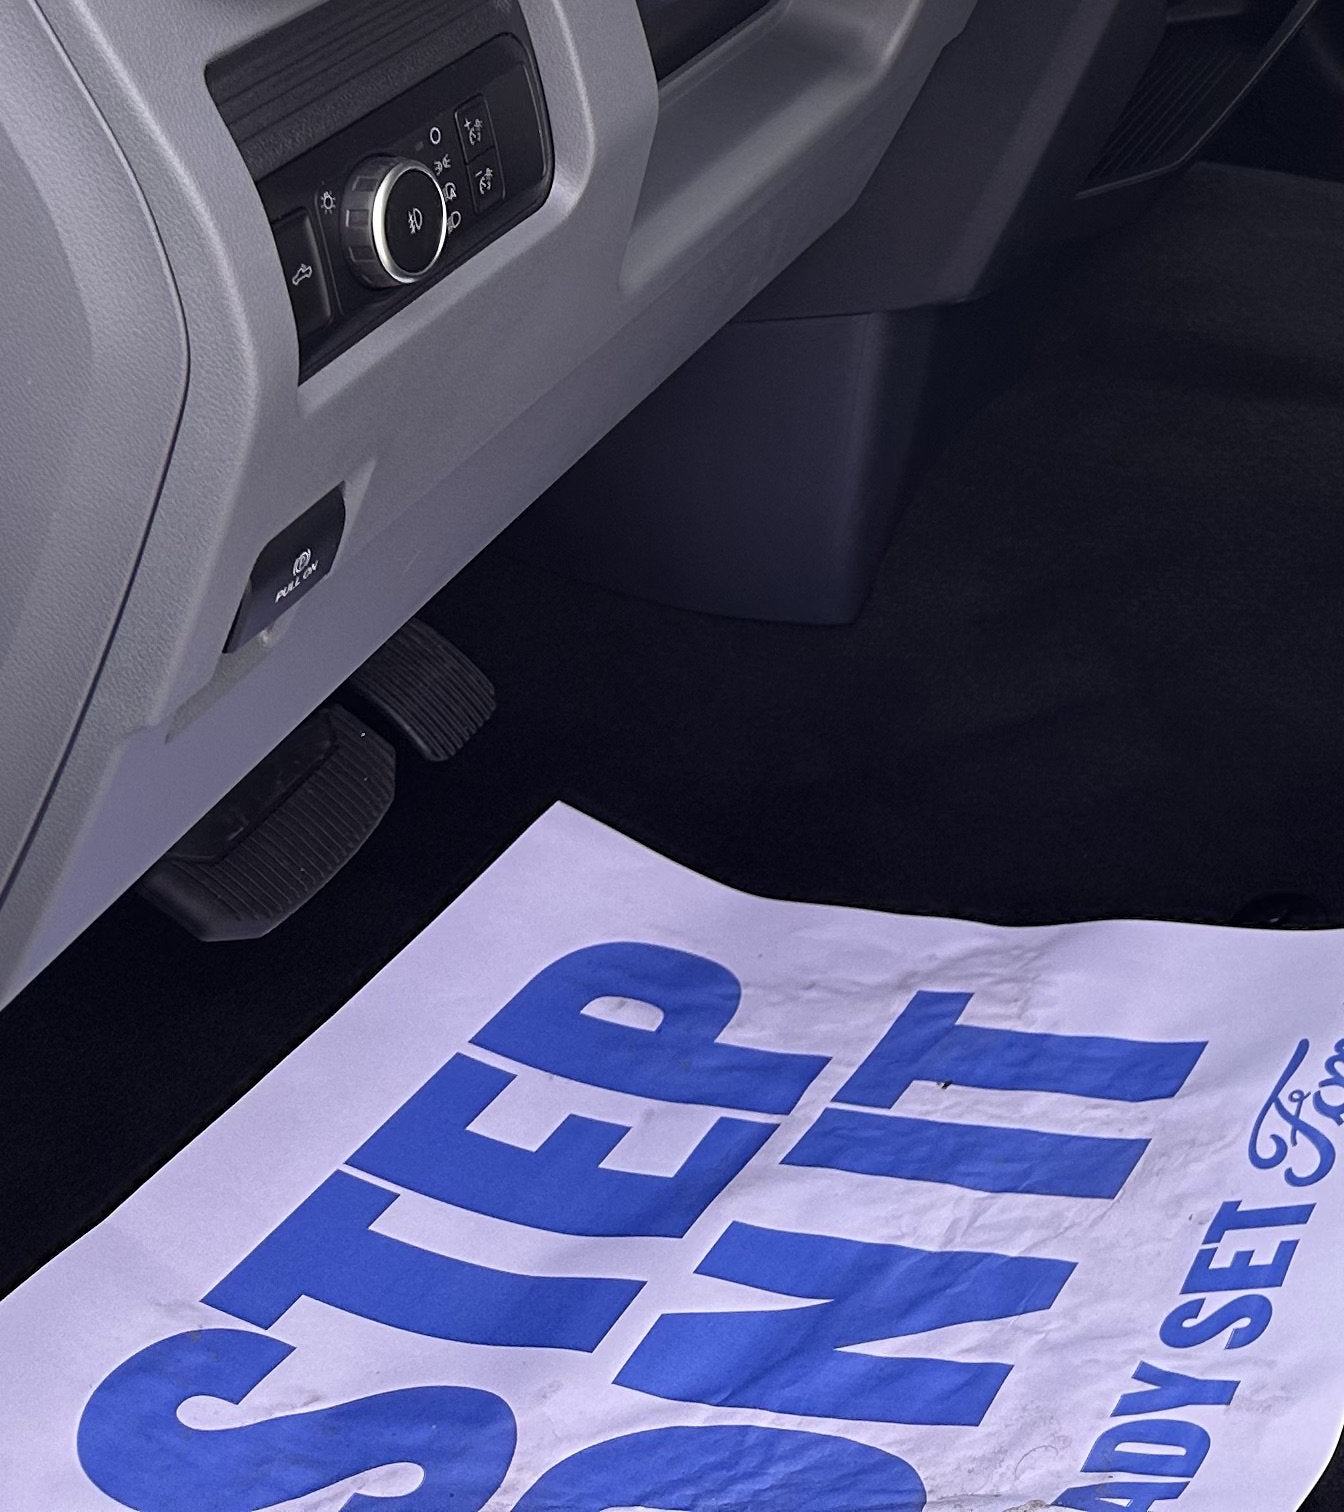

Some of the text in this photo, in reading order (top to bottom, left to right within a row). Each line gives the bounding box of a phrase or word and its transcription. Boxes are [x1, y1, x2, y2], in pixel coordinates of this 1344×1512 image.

[275, 559, 319, 603] PULL ON
[779, 989, 1209, 1201] IT
[77, 940, 833, 1512] STEP
[1158, 1199, 1317, 1350] SET
